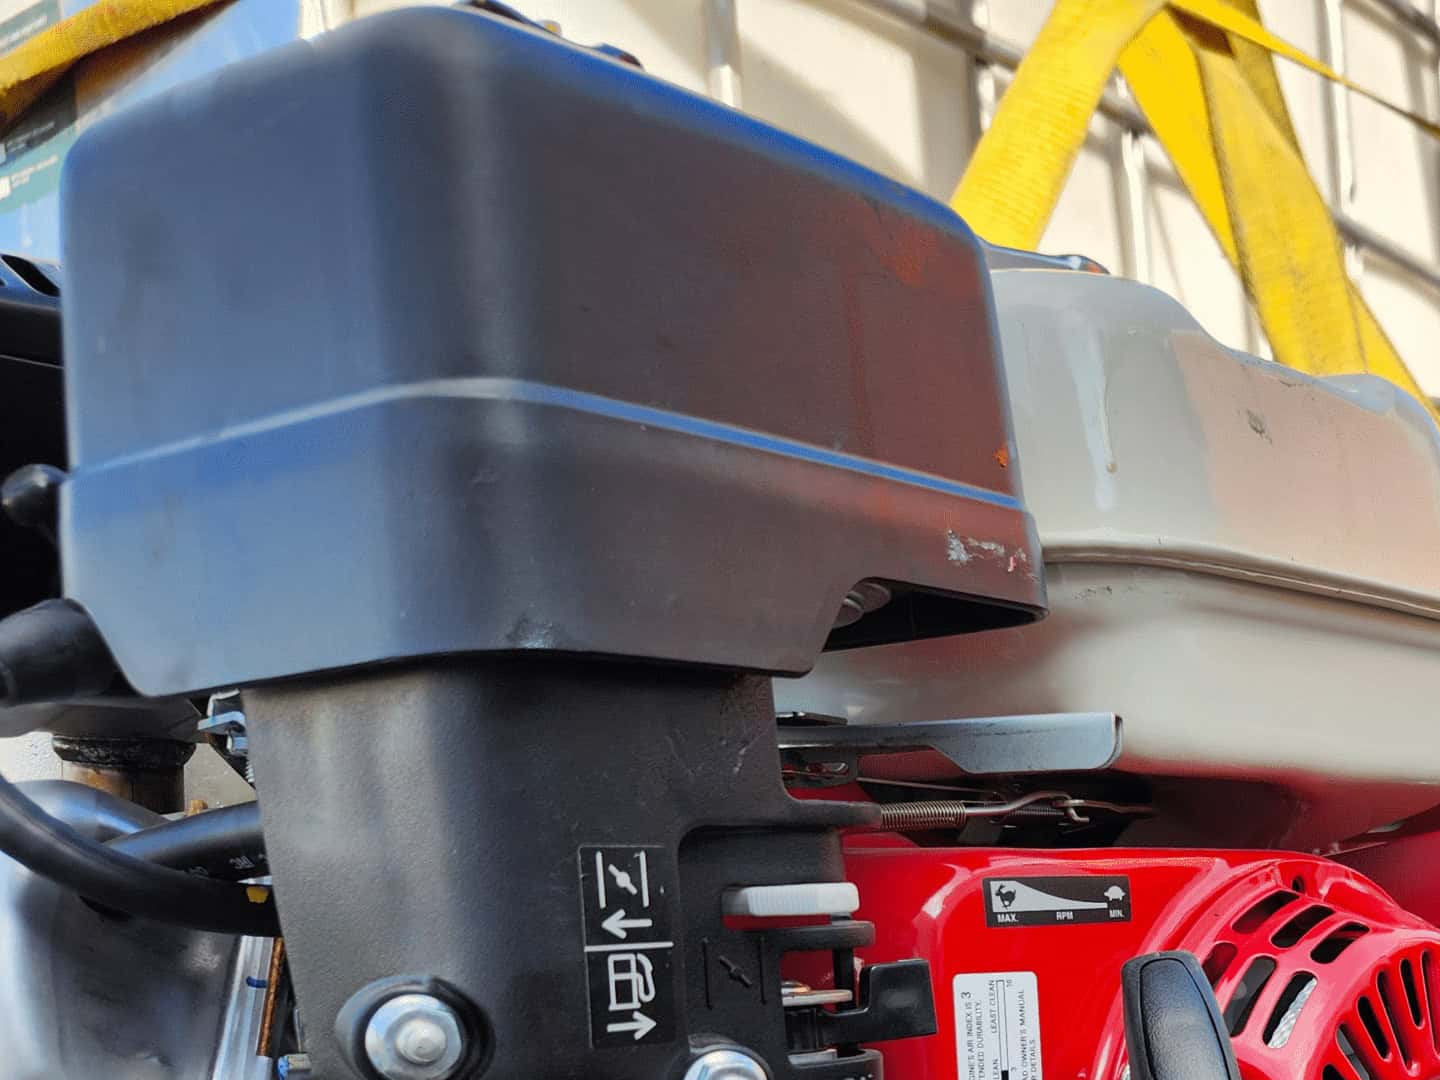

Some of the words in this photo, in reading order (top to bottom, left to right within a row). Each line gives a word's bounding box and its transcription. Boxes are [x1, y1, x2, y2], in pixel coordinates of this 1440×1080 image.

[997, 913, 1019, 923] MAX.
[1056, 911, 1074, 920] RPM
[1109, 909, 1125, 918] MIN.
[988, 980, 996, 1006] CLEAN
[1017, 990, 1026, 1026] MANUAL
[965, 1012, 973, 1037] INDEX
[989, 1009, 997, 1033] LEAST
[1019, 1029, 1029, 1067] OWNER'S
